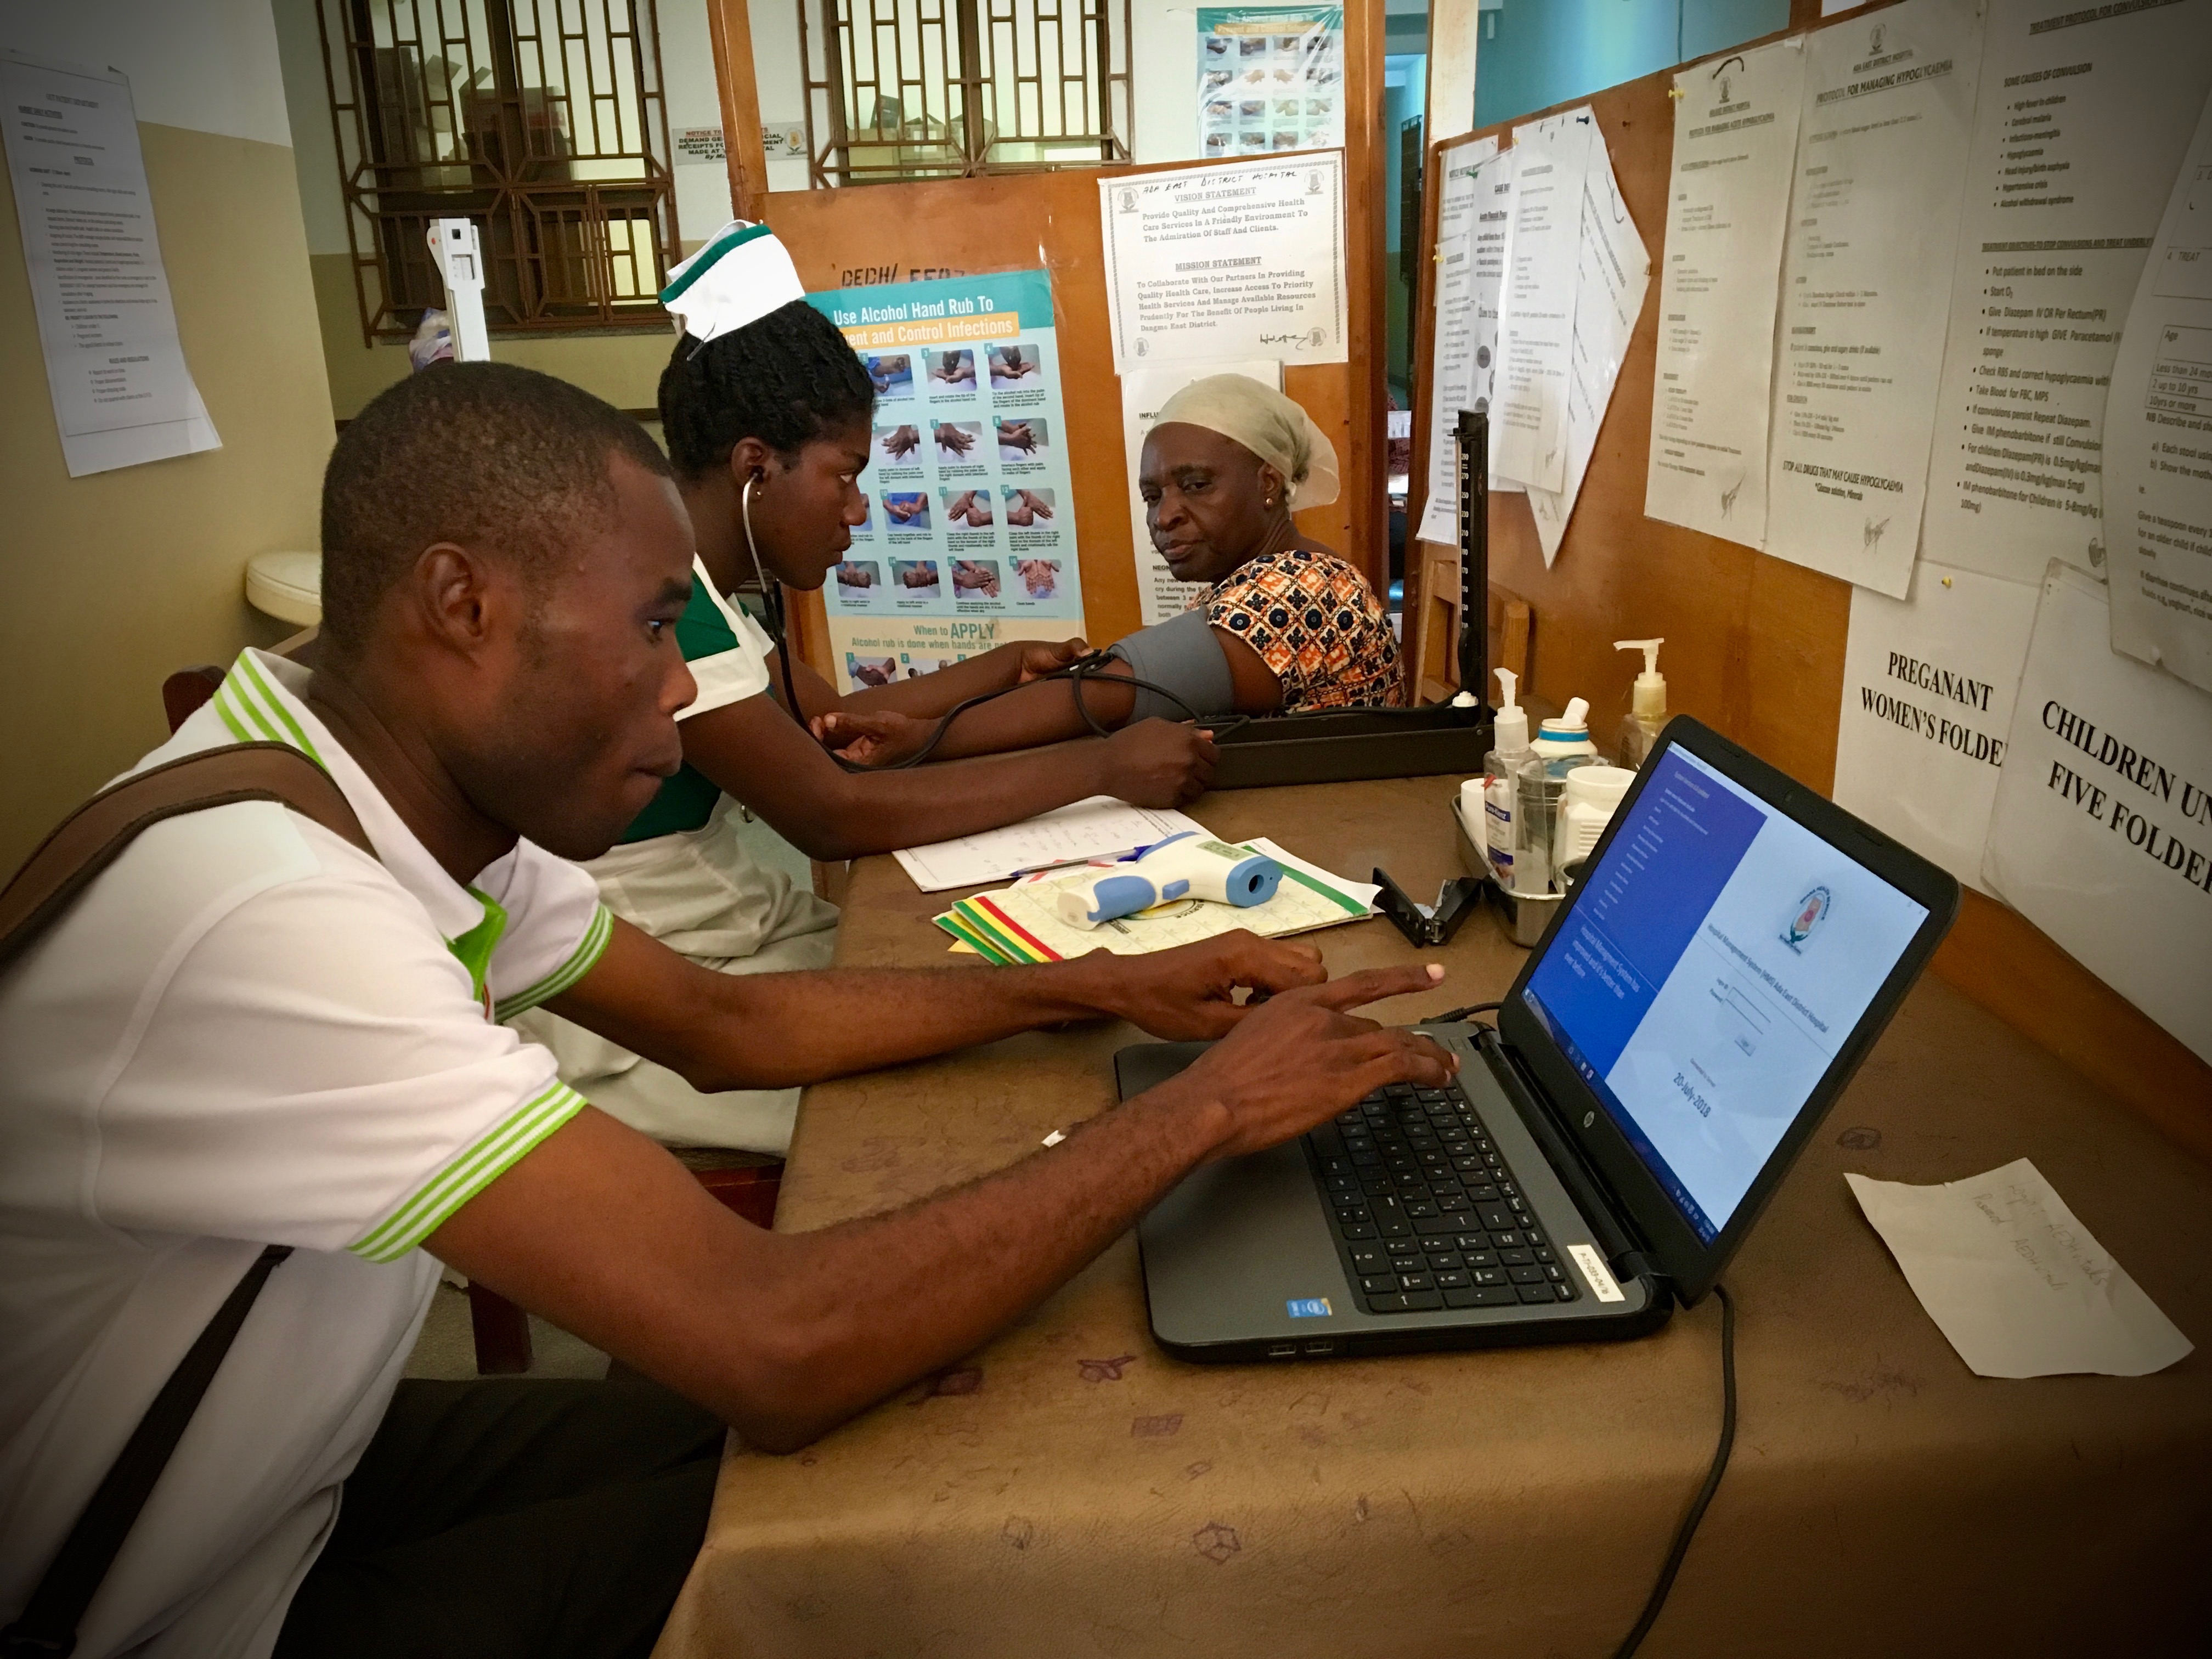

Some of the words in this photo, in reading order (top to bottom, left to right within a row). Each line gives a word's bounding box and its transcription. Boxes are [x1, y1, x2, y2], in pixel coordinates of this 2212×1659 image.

[1847, 83, 1859, 95] FOR
[1860, 74, 1895, 93] MANAGING
[1896, 59, 1953, 83] HYPOGLYCAEMIA
[2004, 75, 2019, 86] SOME
[2021, 71, 2042, 83] CAUSES
[2042, 69, 2051, 80] OF
[2052, 62, 2092, 78] CONVULSION
[1165, 181, 1187, 191] EAST
[1201, 175, 1244, 187] DISTRICT
[1175, 192, 1203, 202] VISION
[1205, 187, 1256, 200] STATEMENT
[1142, 211, 1169, 219] Provide
[1172, 209, 1199, 218] Quality
[1217, 202, 1275, 214] Comprehensive
[1278, 198, 1304, 206] Health
[1212, 215, 1242, 224] Friendly
[1244, 211, 1295, 221] Environment
[1160, 232, 1200, 240] Admiration
[1175, 261, 1209, 270] MISSION
[1212, 257, 1261, 268] STATEMENT
[2178, 252, 2200, 262] TREAT
[1148, 279, 1189, 287] Collaborate
[1268, 269, 1305, 278] Providing
[1992, 266, 2002, 276] Put
[2003, 266, 2025, 276] patient
[2026, 266, 2032, 275] in
[2033, 266, 2046, 275] bed
[2057, 266, 2068, 275] the
[2069, 266, 2083, 275] side
[1137, 291, 1163, 300] Quality
[1165, 289, 1189, 297] Health
[1242, 294, 1274, 302] Available
[1990, 286, 2005, 296] Start
[833, 309, 856, 326] Use
[861, 303, 907, 323] Alcohol
[911, 300, 944, 318] Hand
[949, 297, 973, 314] Rub
[978, 296, 993, 312] To
[1244, 306, 1268, 314] People
[1988, 306, 2001, 317] Give
[2004, 307, 2033, 319] Diazepam
[2036, 307, 2043, 318] IV
[2044, 308, 2053, 318] OR
[2055, 308, 2066, 319] Per
[2067, 308, 2106, 321] Rectum(PR)
[872, 327, 894, 344] and
[898, 323, 943, 342] Control
[947, 319, 1012, 337] Infections
[2165, 330, 2178, 342] Age
[1976, 385, 1989, 395] Take
[1989, 386, 2007, 397] Blood
[2009, 388, 2018, 398] for
[2019, 389, 2032, 400] FBC,
[2034, 391, 2049, 402] MPS
[1783, 460, 1794, 471] STOP
[1803, 464, 1819, 476] DRUGS
[1819, 467, 1831, 478] THAT
[1832, 470, 1843, 481] MAY
[1843, 471, 1860, 484] CAUSE
[1860, 475, 1903, 493] HYPOGLYCAEMIA
[1961, 499, 1981, 512] 100mg)
[914, 625, 936, 635] When
[940, 627, 947, 635] to
[951, 623, 994, 639] APPLY
[852, 637, 879, 646] Alcohol
[883, 639, 895, 647] rub
[898, 638, 904, 647] is
[907, 639, 926, 648] done
[928, 639, 949, 648] when
[951, 640, 976, 649] hands
[978, 641, 992, 650] are
[1887, 652, 1993, 711] PREGANANT
[1861, 687, 1936, 740] WOMEN'S
[2042, 701, 2177, 802] CHILDREN
[2047, 760, 2106, 820] FIVE
[1746, 957, 1763, 975] System
[1773, 981, 1784, 994] Ada
[1782, 989, 1793, 1002] East
[1791, 997, 1809, 1018] District
[1808, 1011, 1830, 1034] Hospital
[1673, 1072, 1711, 1118] 20-July-2018
